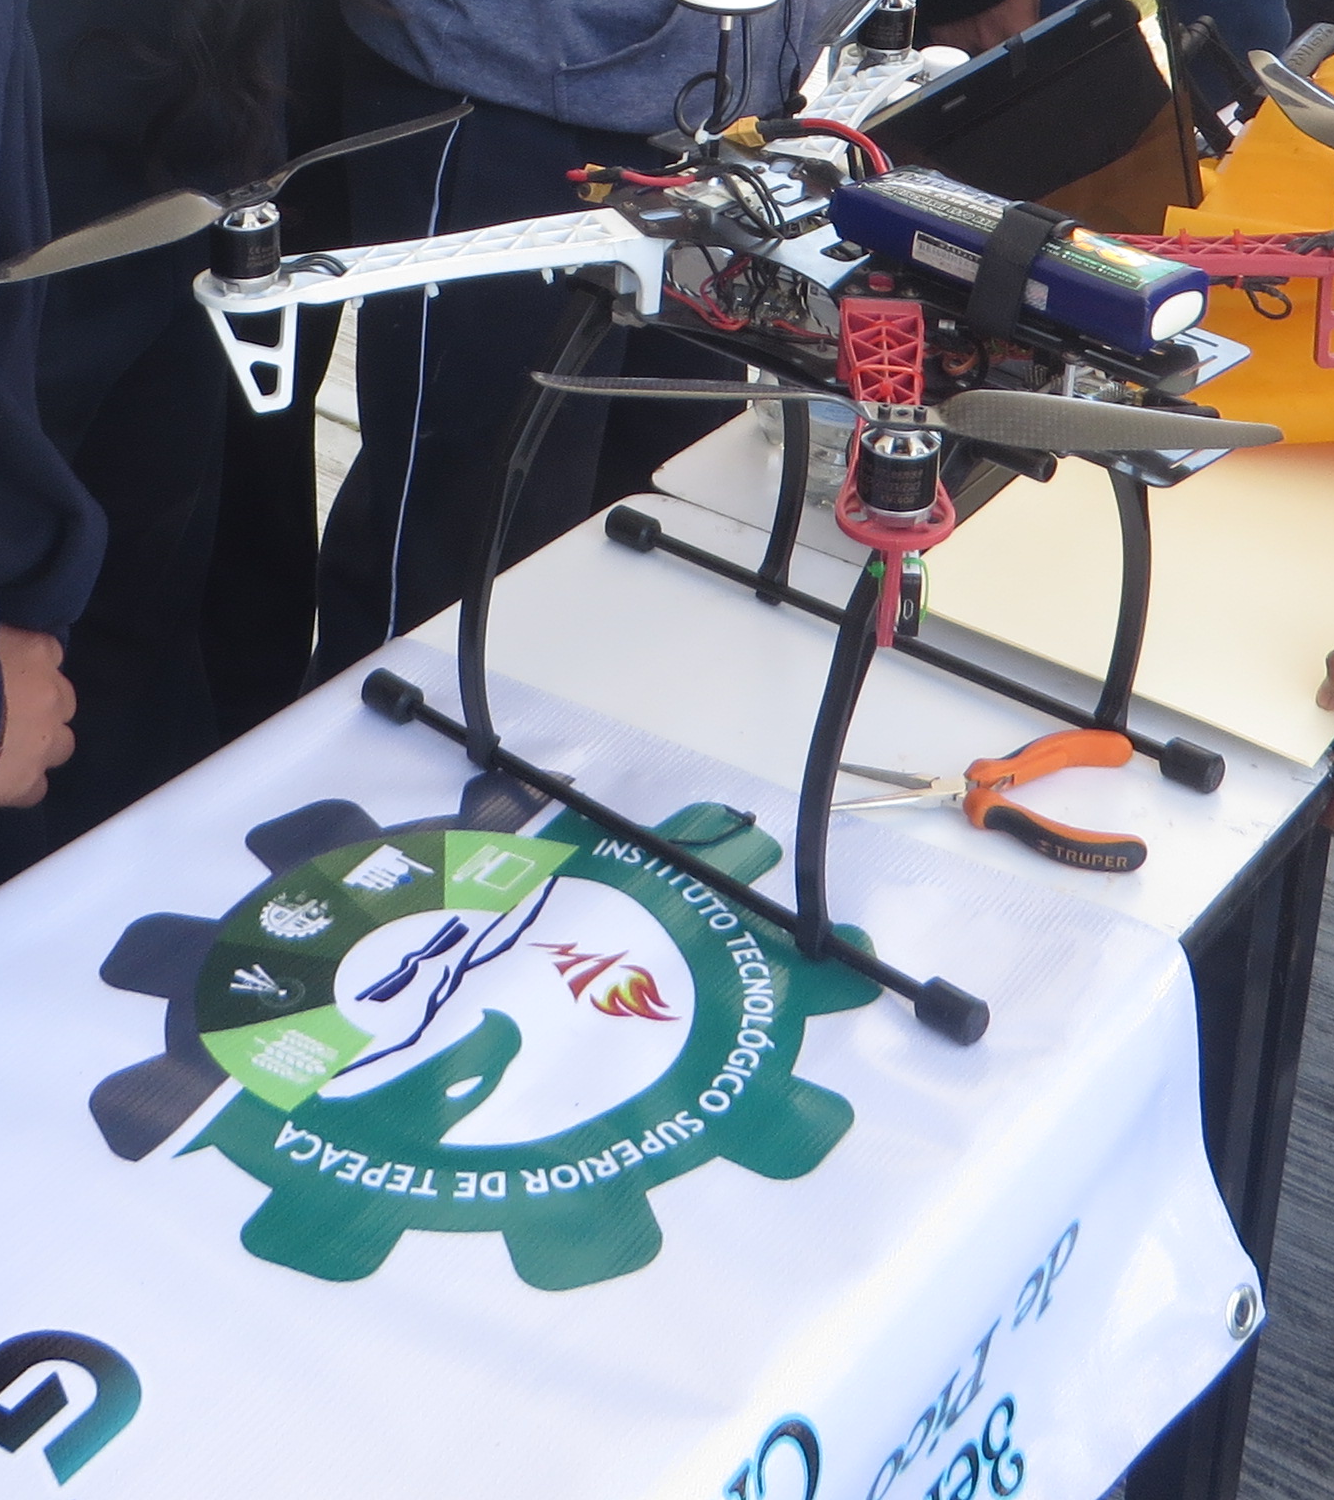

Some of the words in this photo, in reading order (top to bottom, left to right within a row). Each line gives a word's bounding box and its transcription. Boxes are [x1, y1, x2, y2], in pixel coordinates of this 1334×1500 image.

[1055, 845, 1128, 868] TRUPER
[698, 930, 775, 1113] TECNOLÓGICO
[273, 1120, 438, 1198] TEPEACA
[452, 1170, 507, 1199] DE
[520, 1110, 705, 1196] SUPERIOR
[1012, 1218, 1080, 1331] de
